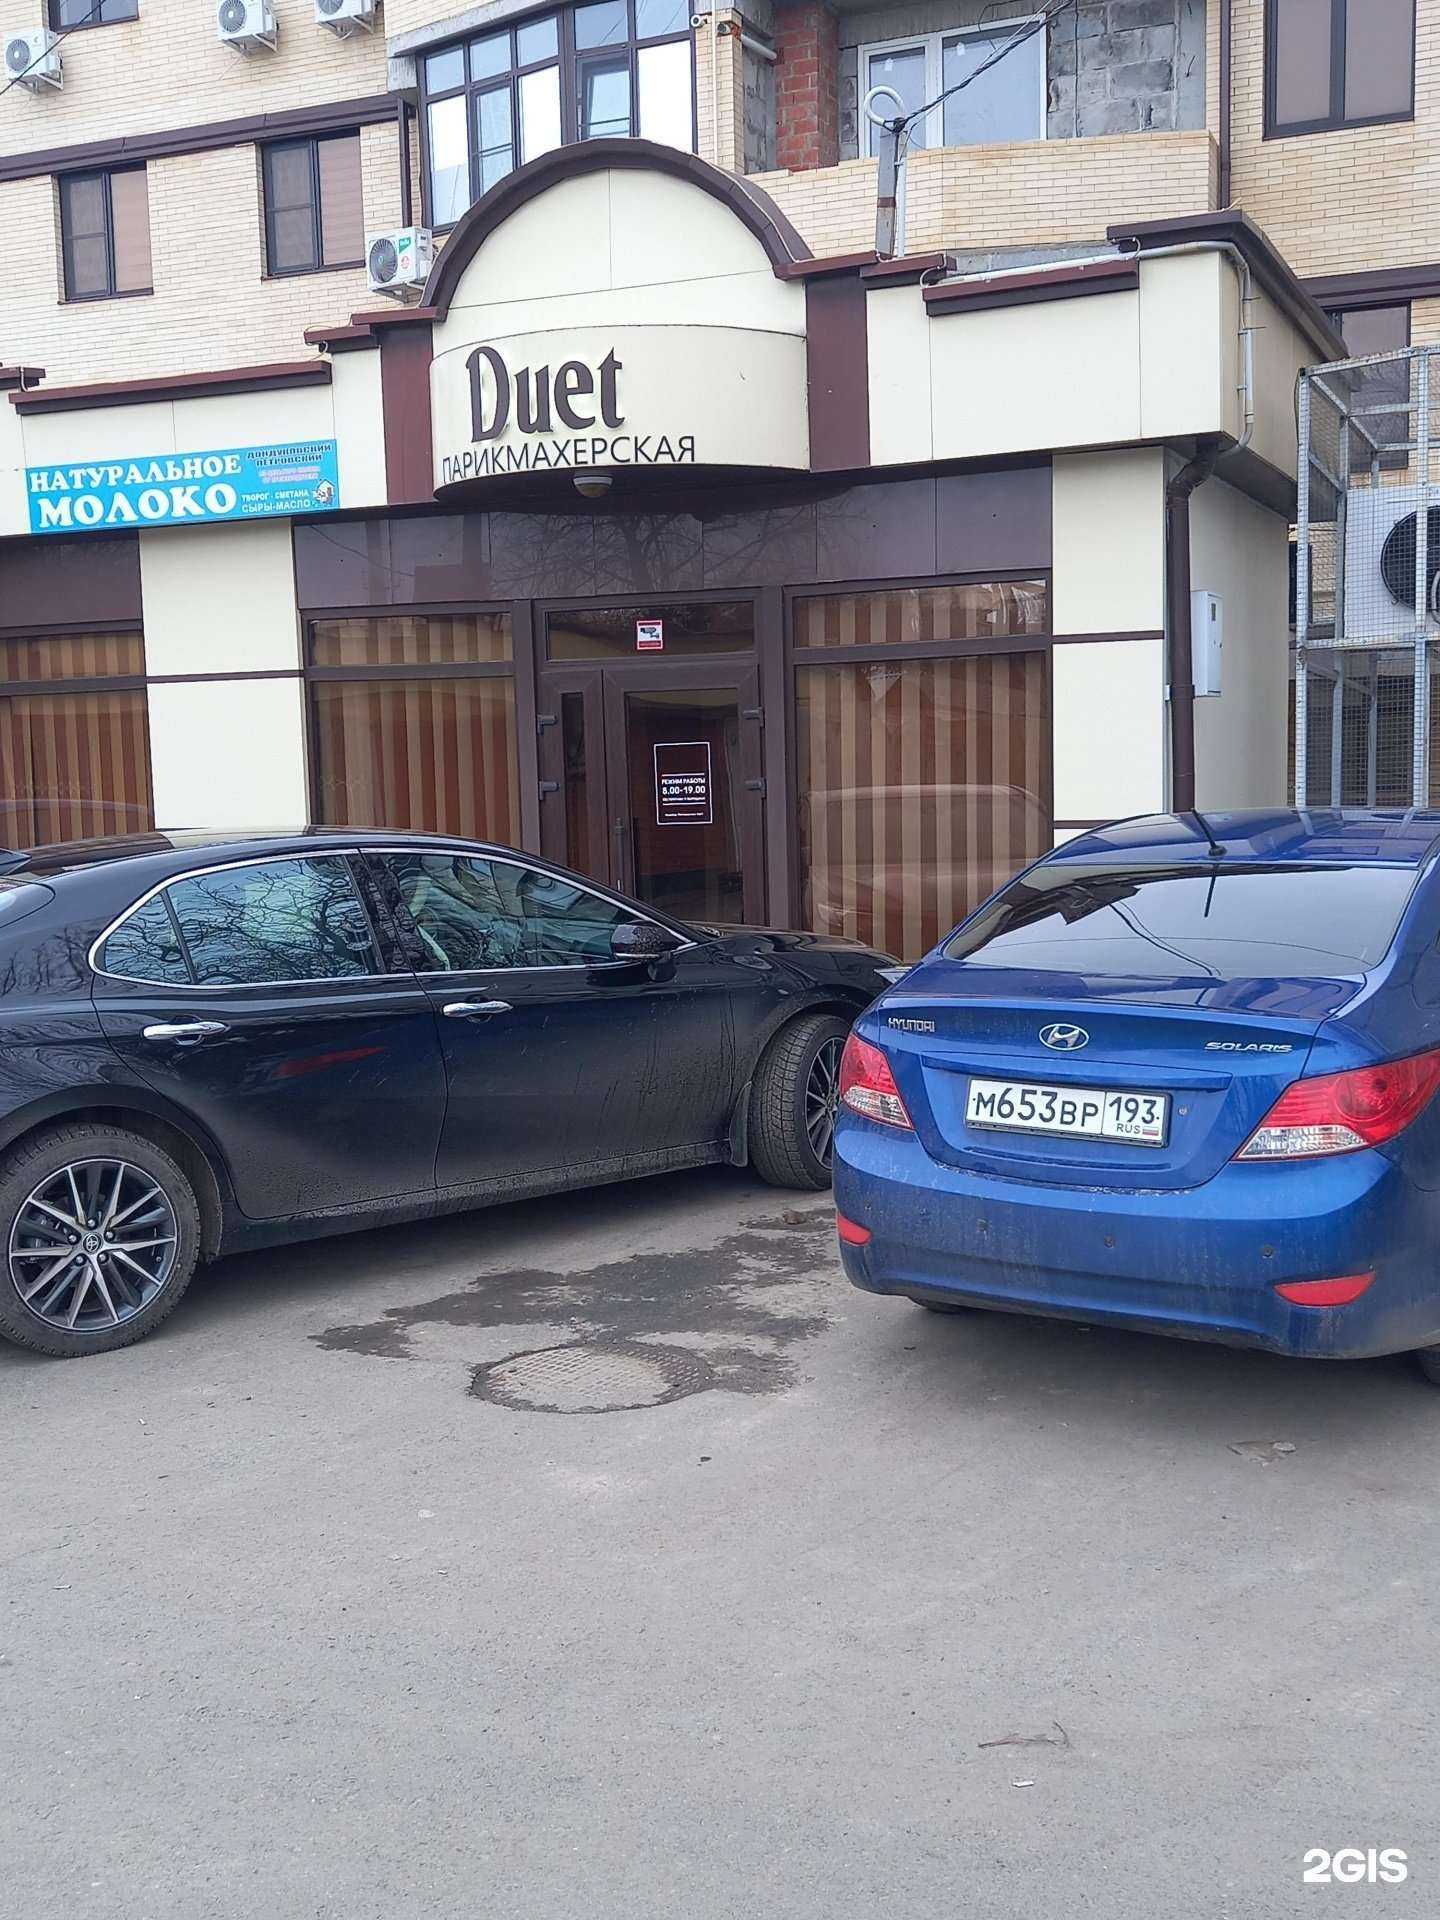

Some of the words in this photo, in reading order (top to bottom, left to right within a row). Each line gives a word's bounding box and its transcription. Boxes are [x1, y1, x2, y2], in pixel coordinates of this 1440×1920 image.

[465, 345, 626, 443] Duet
[442, 435, 695, 484] ПАРИКМАХЕРСКАЯ
[29, 454, 242, 493] НАТУРАЛЬНОЕ
[37, 482, 238, 529] МОЛОКО
[275, 488, 310, 501] СМЕТАНА
[888, 1017, 936, 1033] HYUNDAI
[1204, 1041, 1293, 1053] SOLARIS
[1116, 1122, 1141, 1135] RUS
